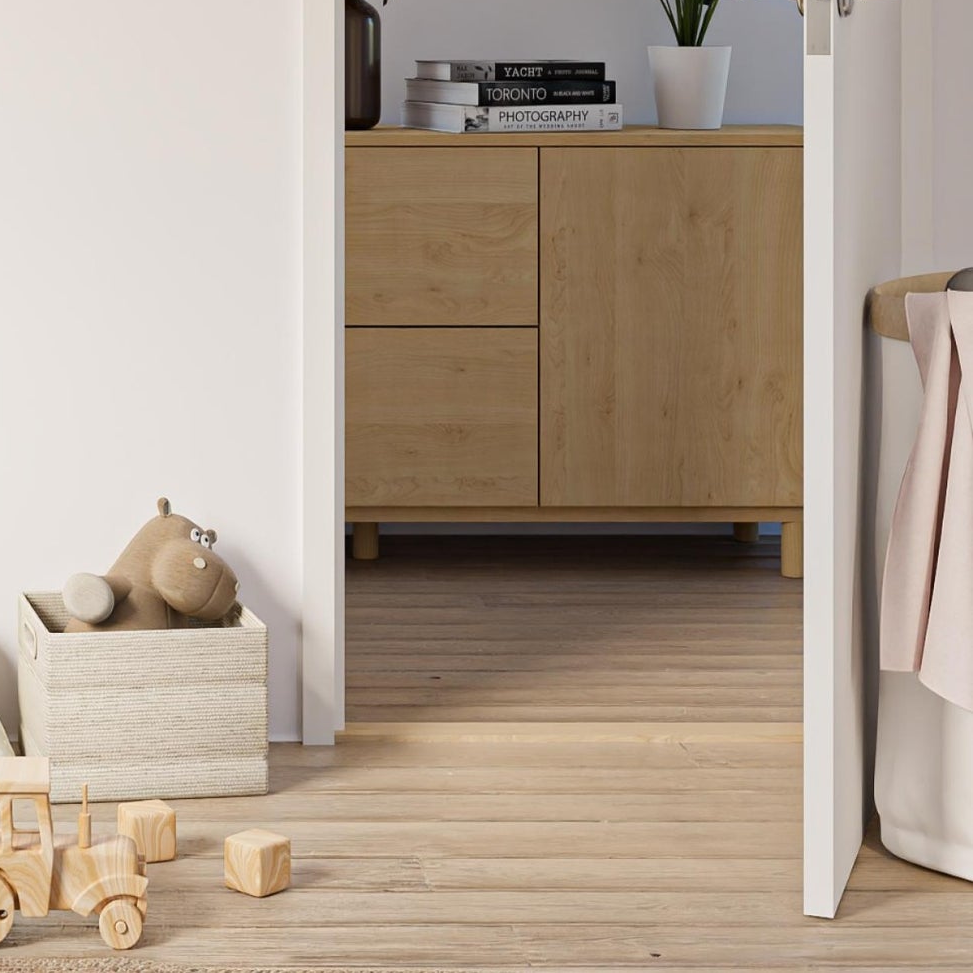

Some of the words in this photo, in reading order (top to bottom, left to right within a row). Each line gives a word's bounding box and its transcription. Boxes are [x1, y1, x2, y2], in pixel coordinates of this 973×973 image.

[503, 66, 544, 78] YACHT
[485, 87, 547, 102] TORONTO
[498, 110, 589, 123] PHOTOGRAPHY
